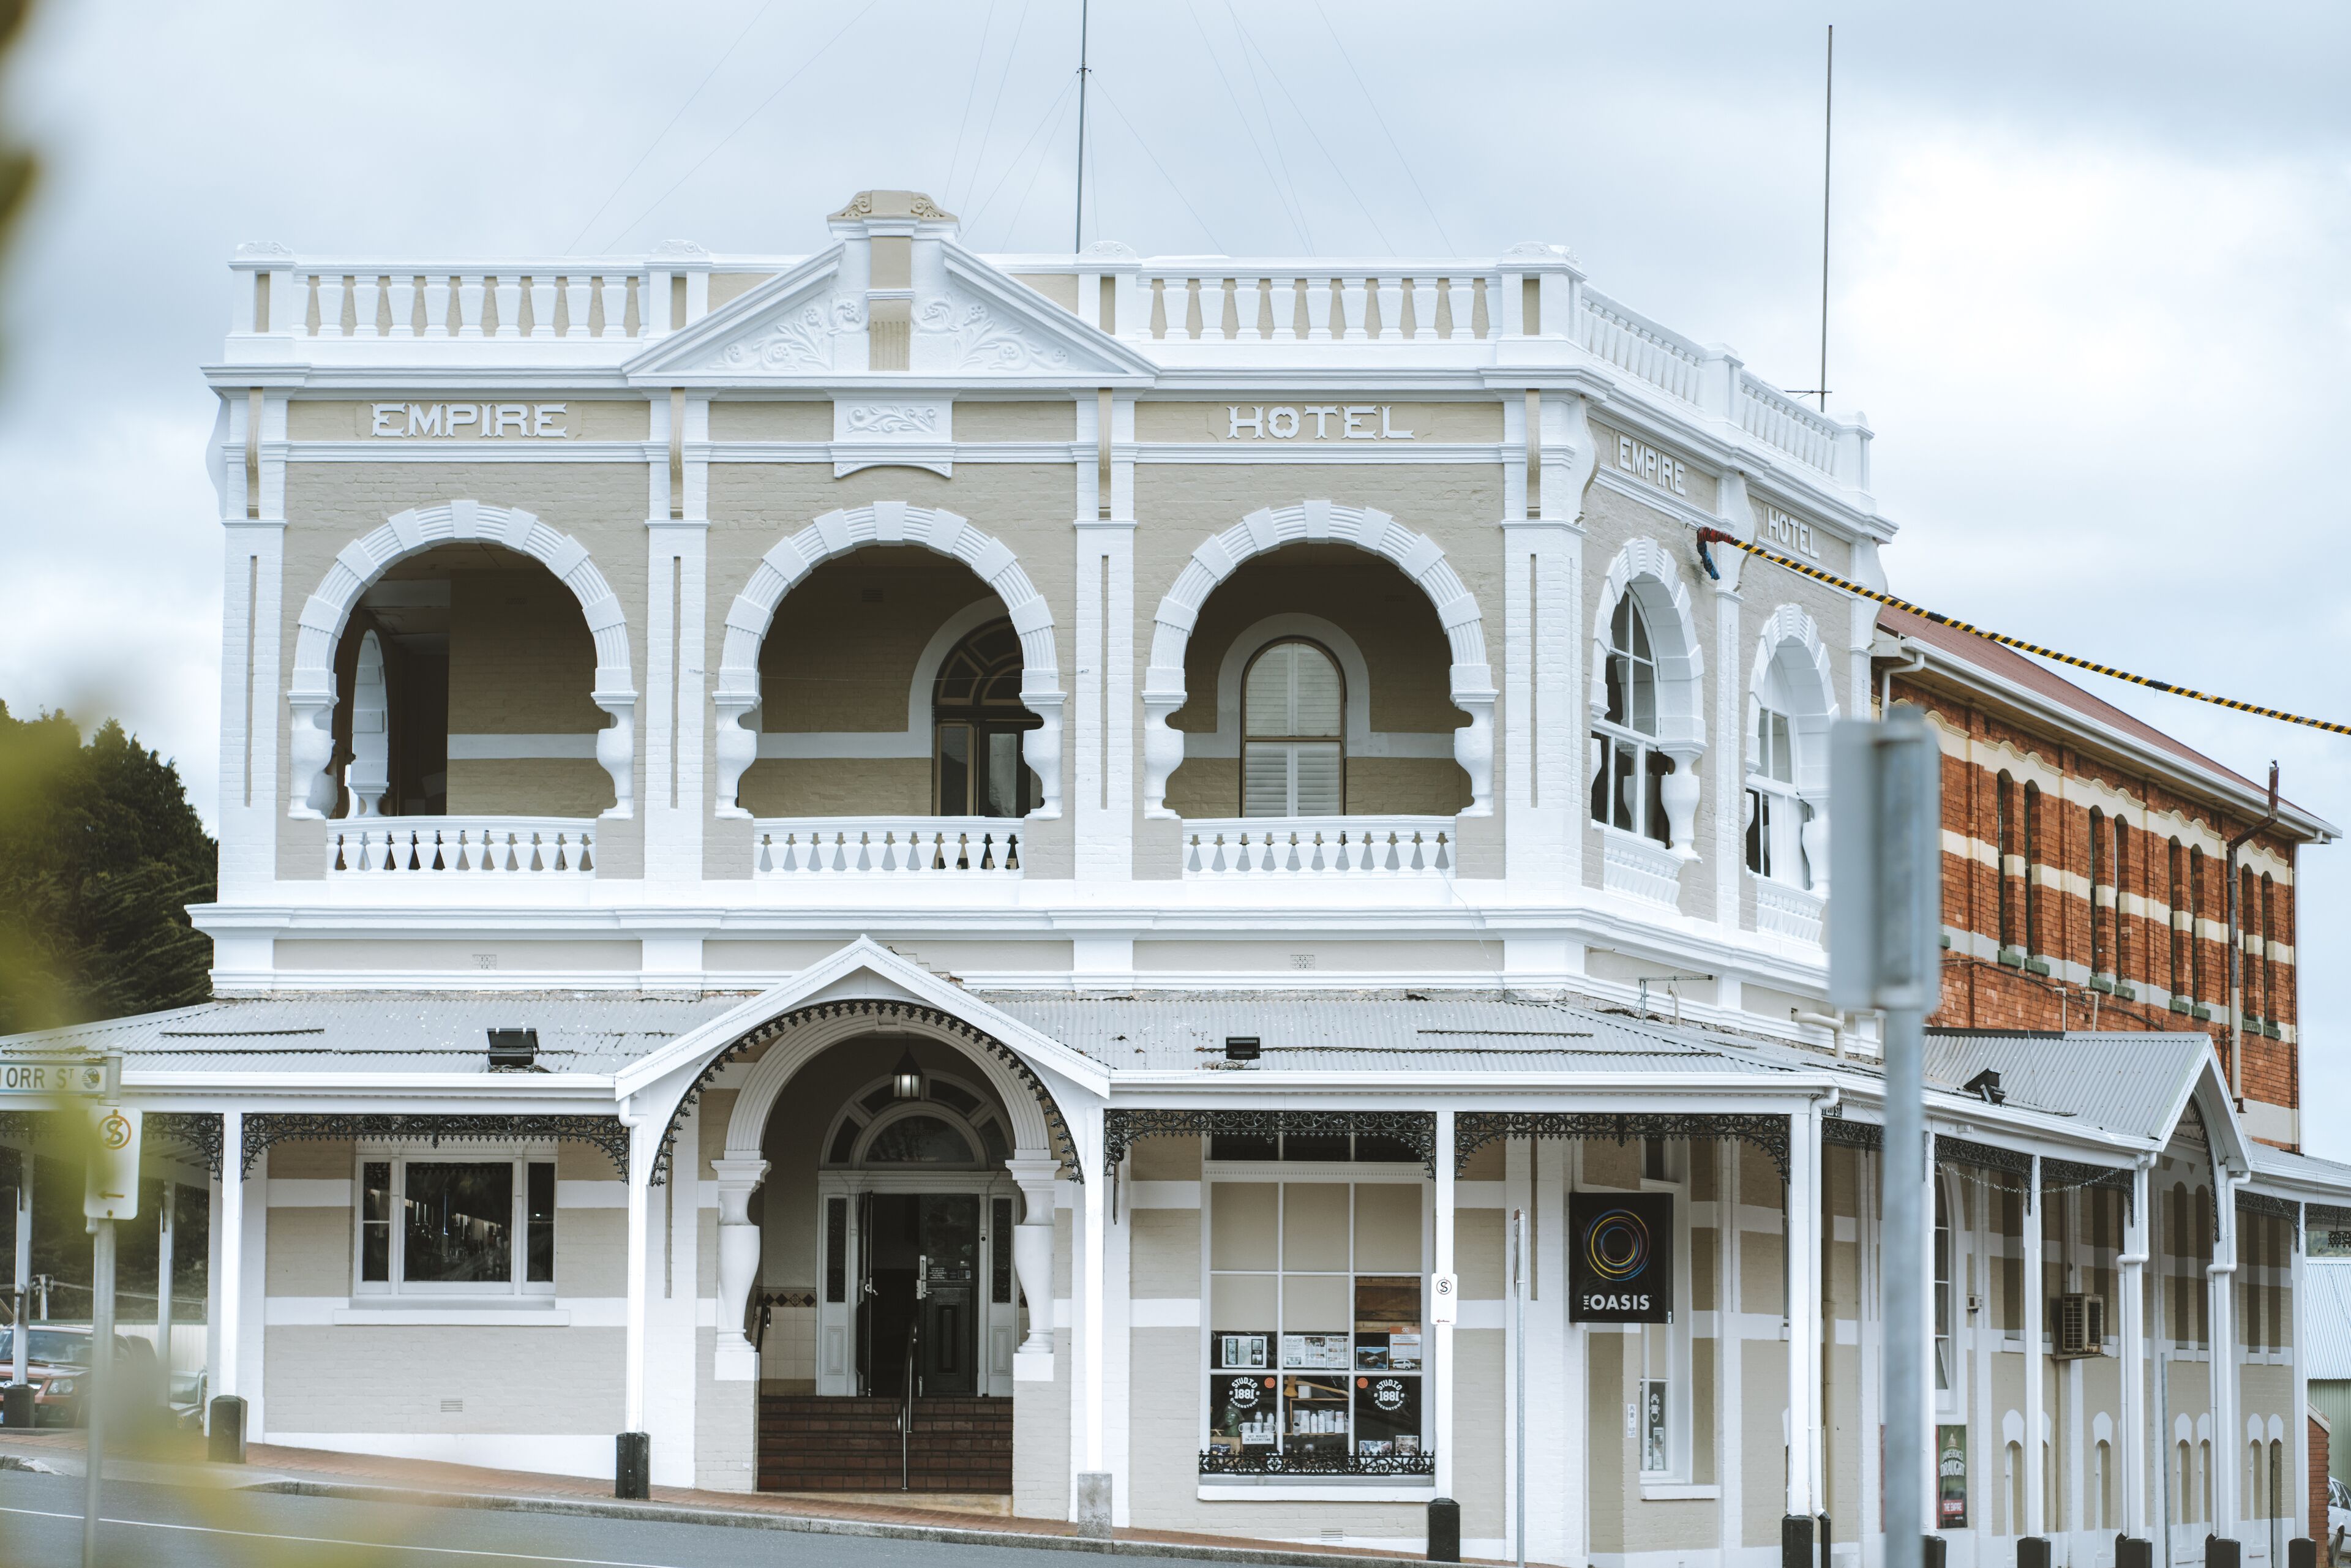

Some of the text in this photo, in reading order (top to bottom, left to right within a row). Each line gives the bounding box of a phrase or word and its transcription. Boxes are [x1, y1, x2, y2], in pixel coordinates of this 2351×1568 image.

[370, 402, 1415, 441] EMPIRE HOTEL
[1618, 435, 1820, 560] EMPIRE HOTEL
[6, 1067, 45, 1089] ORR
[1590, 1294, 1650, 1311] OASIS
[1231, 1377, 1258, 1389] STUDIO
[1376, 1379, 1403, 1390] STUDIO
[1234, 1389, 1254, 1399] 1881
[1379, 1390, 1400, 1401] 1881
[1230, 1397, 1259, 1409] QUEENSTOWN
[1374, 1400, 1403, 1411] QUEENSTOWN
[1940, 1460, 1965, 1477] DRAUGHT
